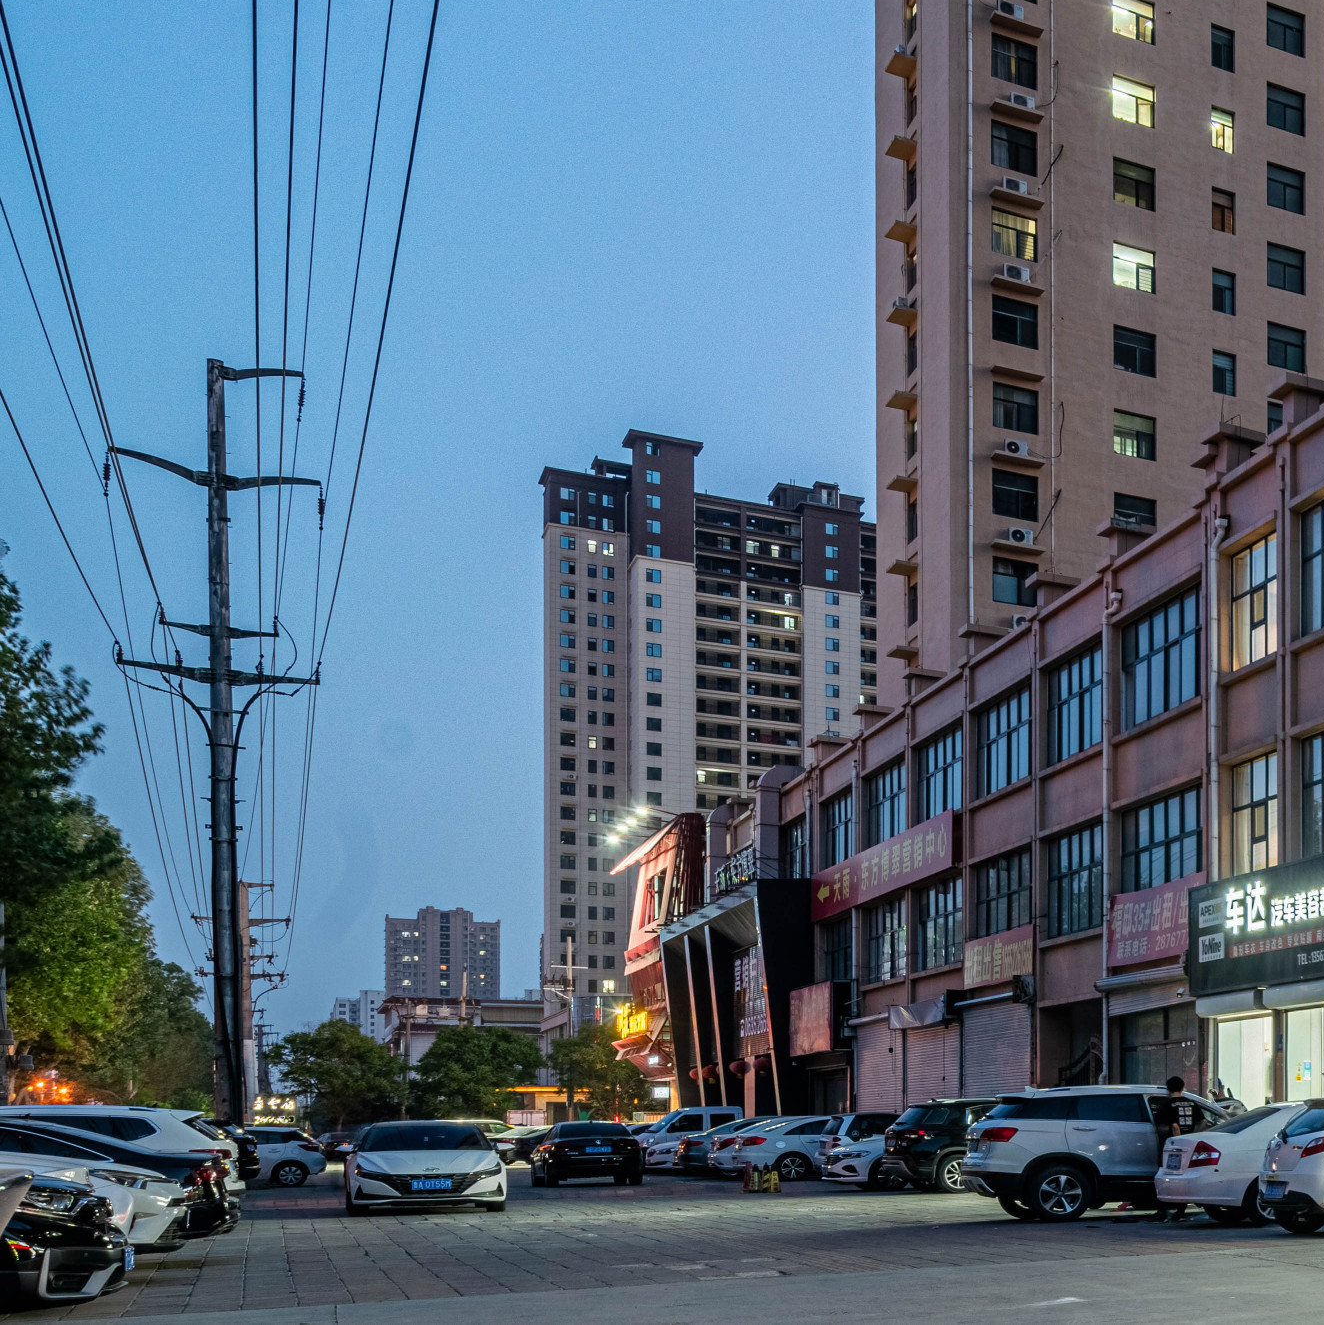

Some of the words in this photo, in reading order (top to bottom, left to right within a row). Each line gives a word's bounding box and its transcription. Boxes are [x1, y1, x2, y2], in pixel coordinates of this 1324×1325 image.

[1111, 885, 1189, 939] 福邸35#出租/出
[1200, 903, 1217, 918] APEX
[1224, 879, 1267, 935] 车达
